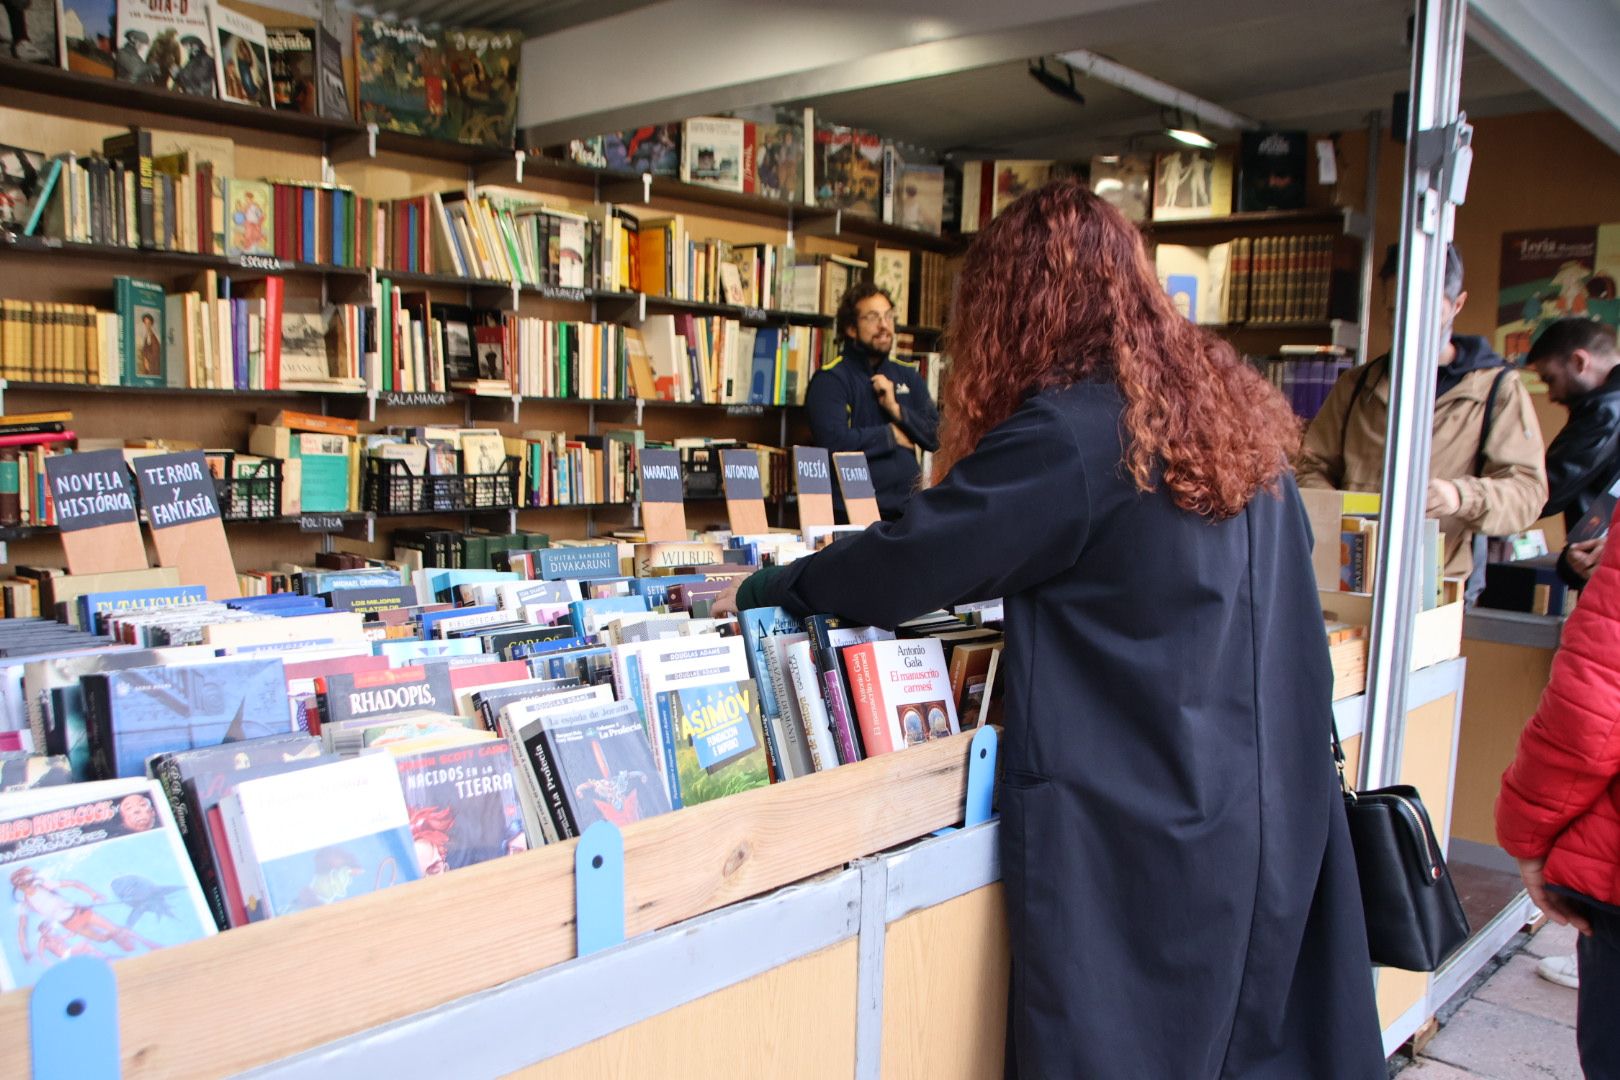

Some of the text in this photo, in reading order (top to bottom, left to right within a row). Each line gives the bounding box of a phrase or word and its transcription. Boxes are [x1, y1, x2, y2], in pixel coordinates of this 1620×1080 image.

[387, 392, 446, 406] SALAMANCA
[145, 461, 203, 485] TERROR
[643, 464, 679, 480] NARRATIVA
[798, 459, 828, 479] POESÍA
[841, 466, 868, 482] TEATRO
[57, 470, 123, 495] NOVELA
[60, 488, 132, 519] HISTÓRICA
[152, 492, 215, 525] FANTASÍA
[550, 559, 611, 573] DIVAKARUNI
[661, 551, 715, 566] WILBUR
[647, 584, 665, 596] SETH
[366, 597, 401, 605] MEJORES
[670, 647, 720, 660] DOUGLAS ADAMS
[897, 644, 926, 656] Antonio
[904, 656, 923, 668] Gala
[849, 653, 870, 704] Antonio Gala
[890, 667, 940, 682] El manuscrito
[903, 680, 933, 693] carmesí
[349, 683, 436, 715] RHADOPIS,
[861, 682, 883, 726] manuscrito
[560, 712, 588, 725] espada
[589, 708, 600, 719] de
[681, 689, 749, 740] ASIMOV
[780, 699, 797, 746] DIAMANTE
[872, 726, 881, 736] El
[407, 765, 493, 790] NACIDOS EN LA
[532, 743, 562, 807] La Profecía
[455, 772, 513, 799] TIERRA
